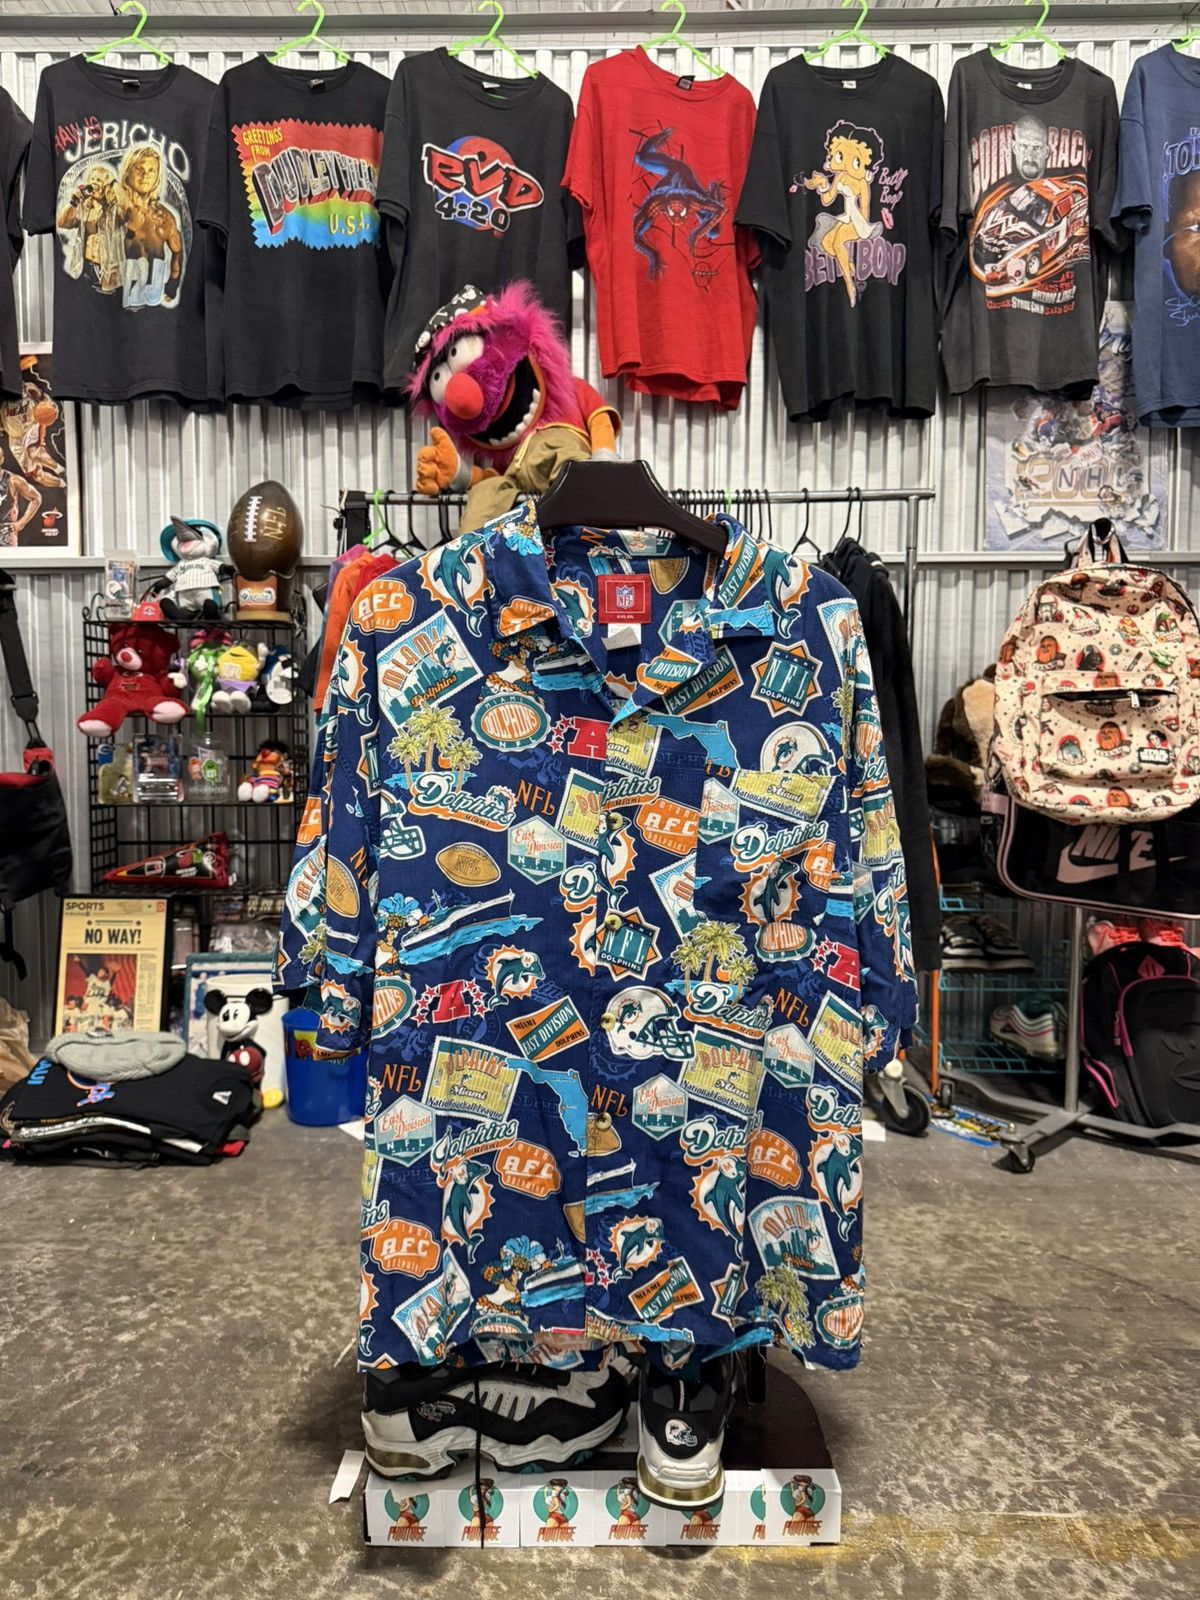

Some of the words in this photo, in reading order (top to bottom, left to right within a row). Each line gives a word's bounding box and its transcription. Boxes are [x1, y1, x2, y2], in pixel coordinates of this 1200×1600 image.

[242, 127, 284, 146] GREETINGS
[65, 120, 191, 181] JERICHO
[250, 145, 271, 163] FROM
[435, 195, 510, 232] 4:20
[735, 539, 755, 583] DIVISION
[358, 592, 404, 619] AFC
[653, 662, 694, 679] DIVISION
[774, 650, 815, 671] MIAMI
[668, 687, 691, 712] EAST
[690, 654, 731, 693] DIVISION
[706, 678, 738, 701] DOLPHINS
[762, 657, 810, 700] NFL
[485, 695, 524, 709] MIAMI
[760, 687, 801, 708] DOLPHINS
[483, 703, 539, 740] DOLPHINS
[415, 772, 515, 825] Dolphins
[515, 779, 556, 816] NFL
[603, 776, 659, 805] phins
[644, 811, 698, 837] AFC
[732, 822, 828, 862] Dolphins
[1070, 824, 1157, 872] NIKE
[65, 901, 105, 911] SPORTS
[84, 927, 103, 944] NO
[107, 927, 142, 945] WAY!
[603, 928, 647, 966] NFL
[601, 952, 642, 973] DOLPHINS
[774, 987, 810, 1028] NFL
[513, 1018, 537, 1031] MIAMI
[521, 1035, 541, 1056] EAST
[538, 1004, 575, 1044] DIVISION
[554, 1029, 586, 1048] DOLPHINS
[381, 1063, 422, 1093] NFL
[449, 1084, 488, 1101] Miami
[590, 1083, 629, 1118] NFL
[807, 1084, 862, 1127] Dolp
[642, 1114, 677, 1124] NFL
[386, 1138, 426, 1152] NFL
[502, 1154, 556, 1178] AFC
[752, 1146, 797, 1173] AFC
[381, 1236, 430, 1258] AFC
[634, 1281, 661, 1301] MIAMI
